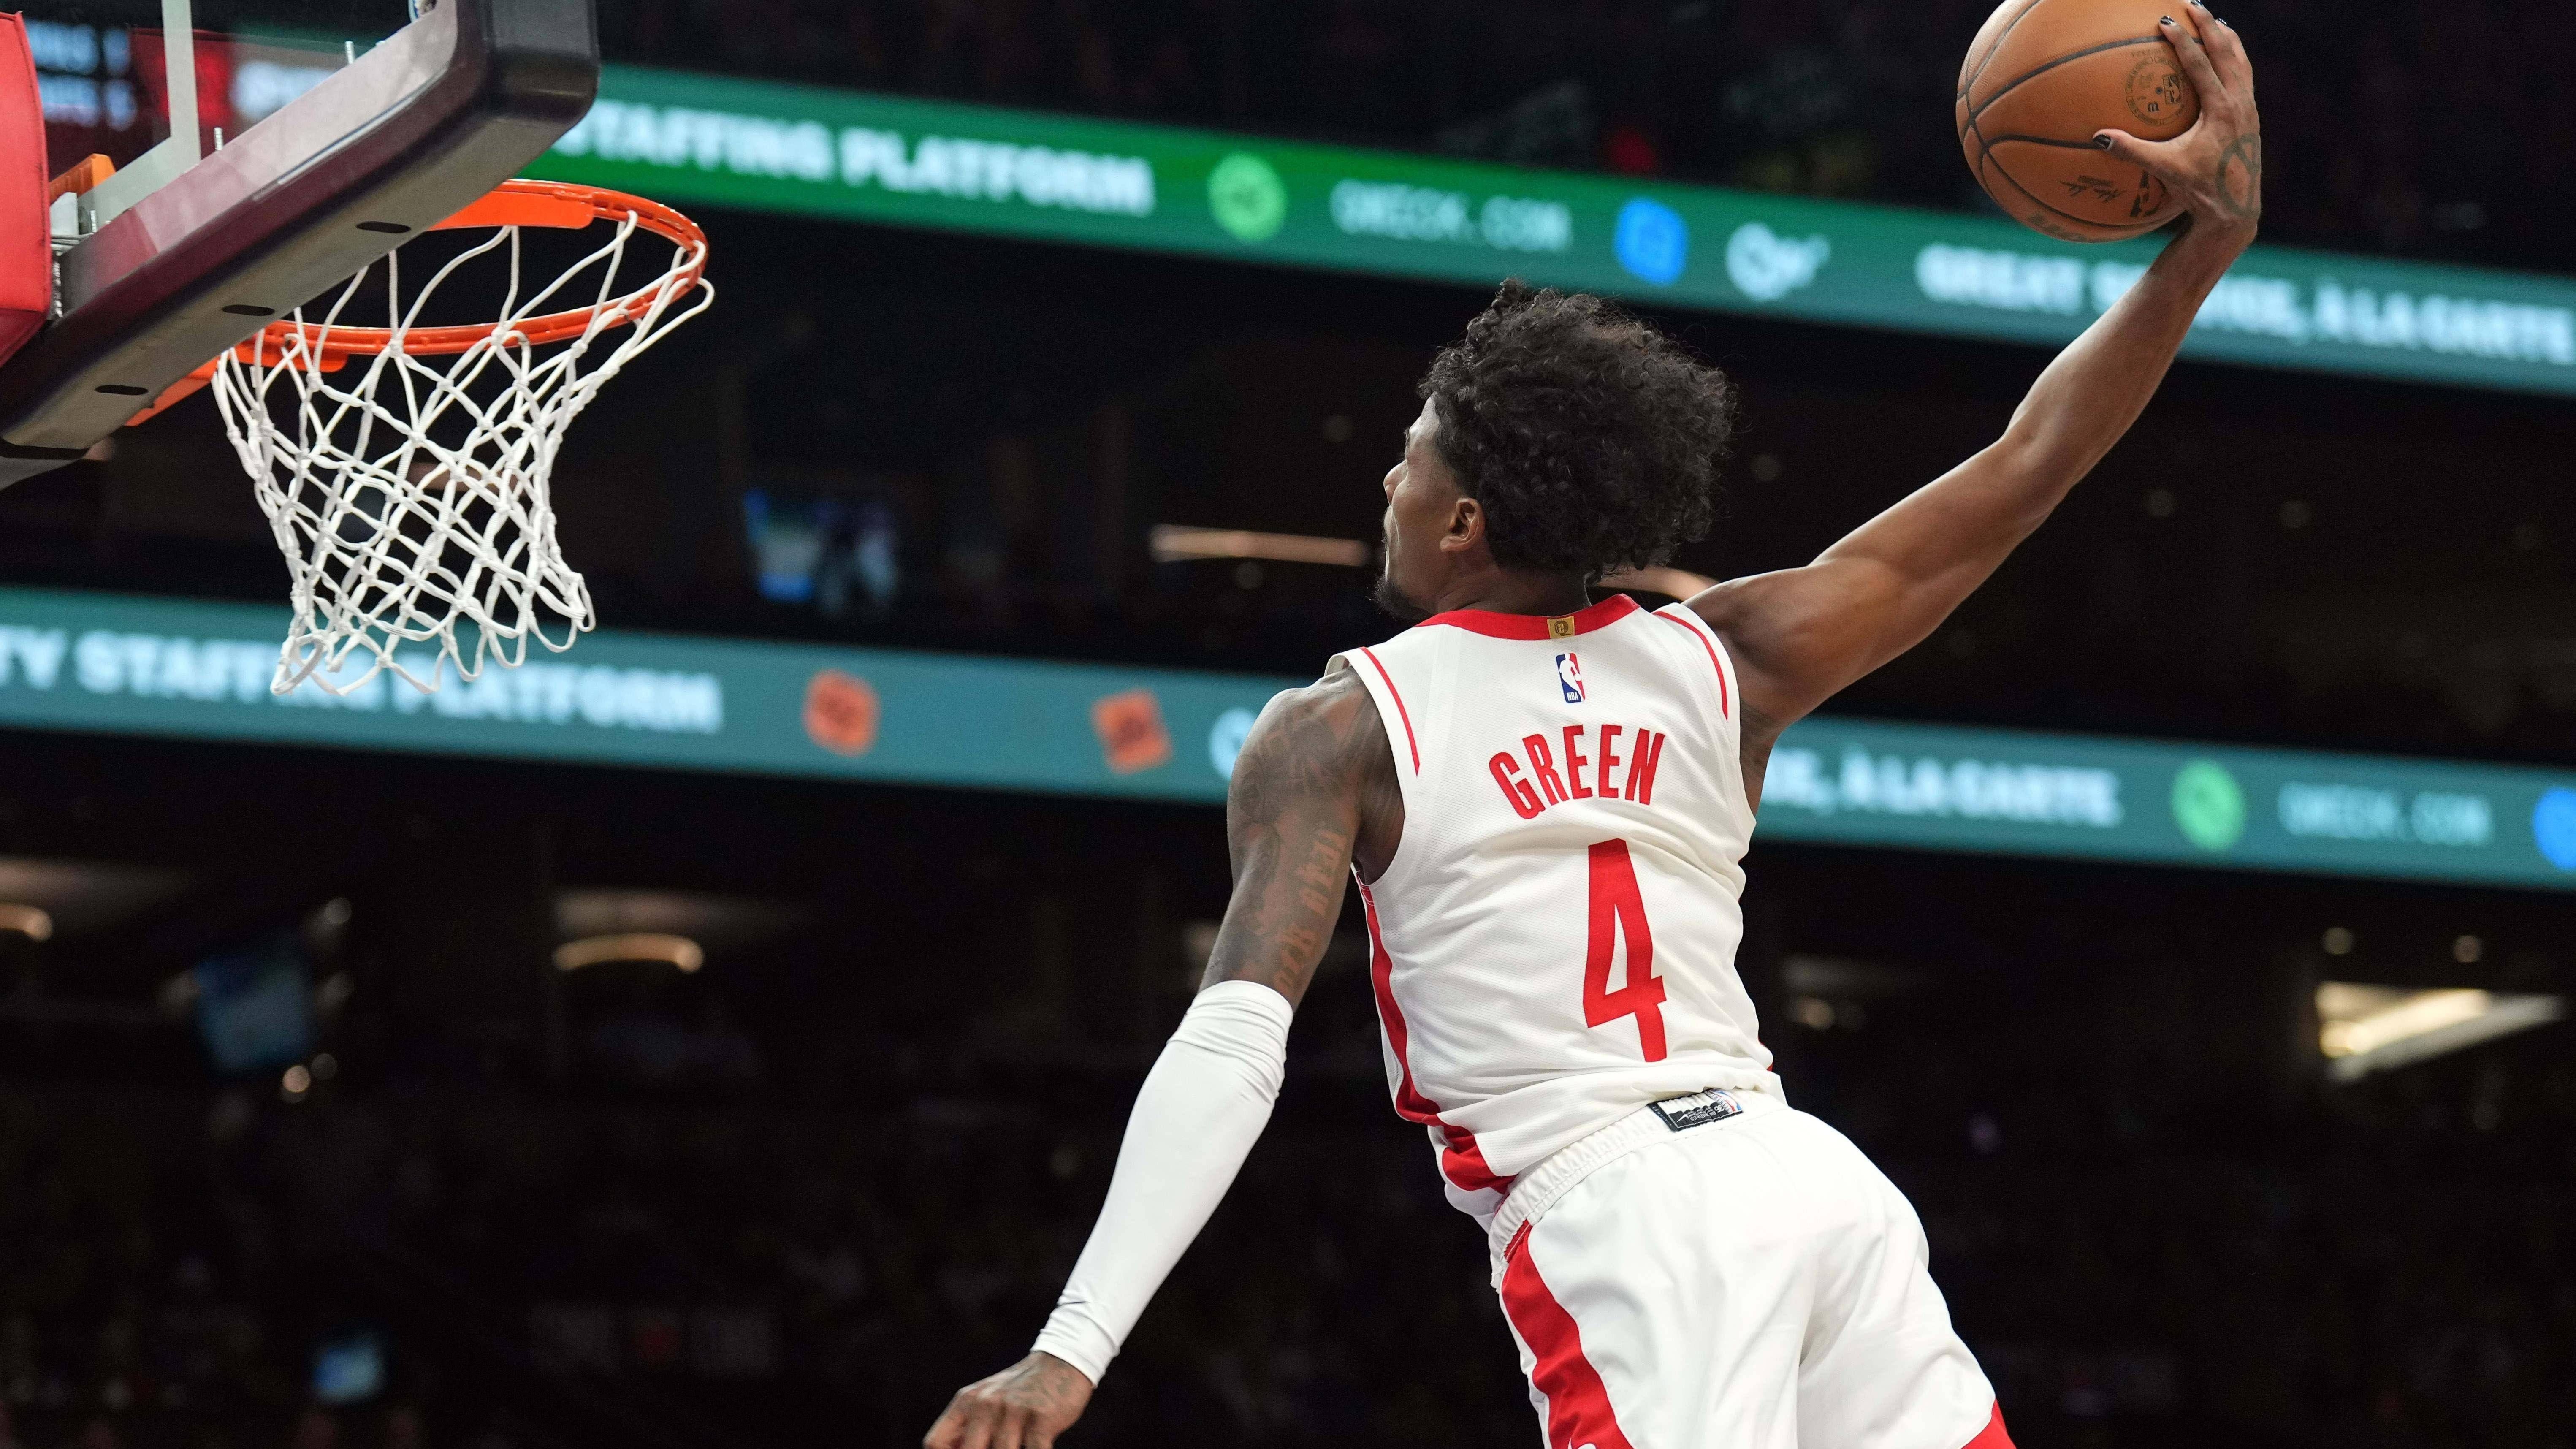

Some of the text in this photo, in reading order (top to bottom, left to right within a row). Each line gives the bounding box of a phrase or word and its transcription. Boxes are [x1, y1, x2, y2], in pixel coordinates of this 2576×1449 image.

[841, 128, 1154, 214] PLATFORM
[1567, 692, 1578, 701] NBA
[1489, 724, 1665, 819] GREEN
[1583, 838, 1666, 1062] 4
